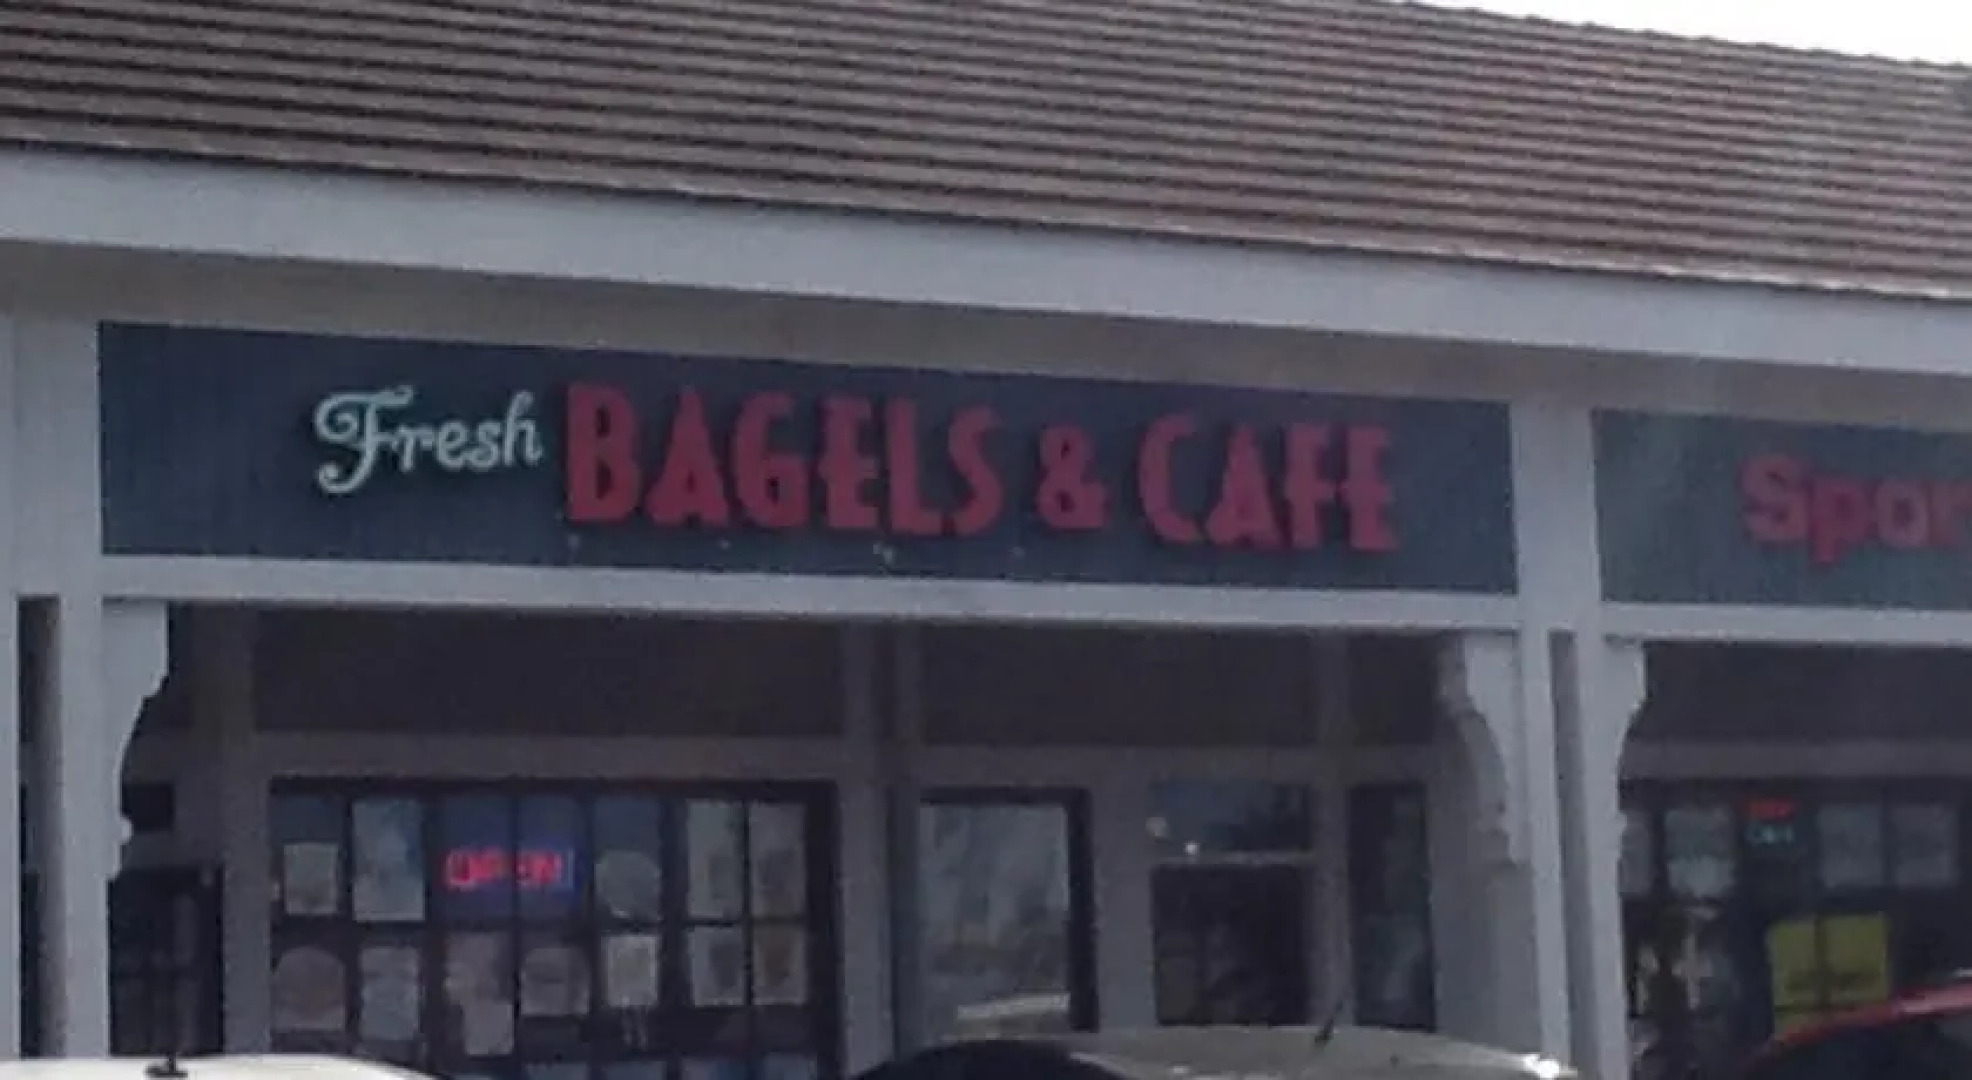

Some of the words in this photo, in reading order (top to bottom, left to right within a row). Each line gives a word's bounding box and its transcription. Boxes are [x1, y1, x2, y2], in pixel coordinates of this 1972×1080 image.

[313, 385, 542, 494] Fresh
[566, 384, 1003, 535] BAGELS
[1037, 424, 1112, 529] &
[1138, 415, 1397, 551] CAFE
